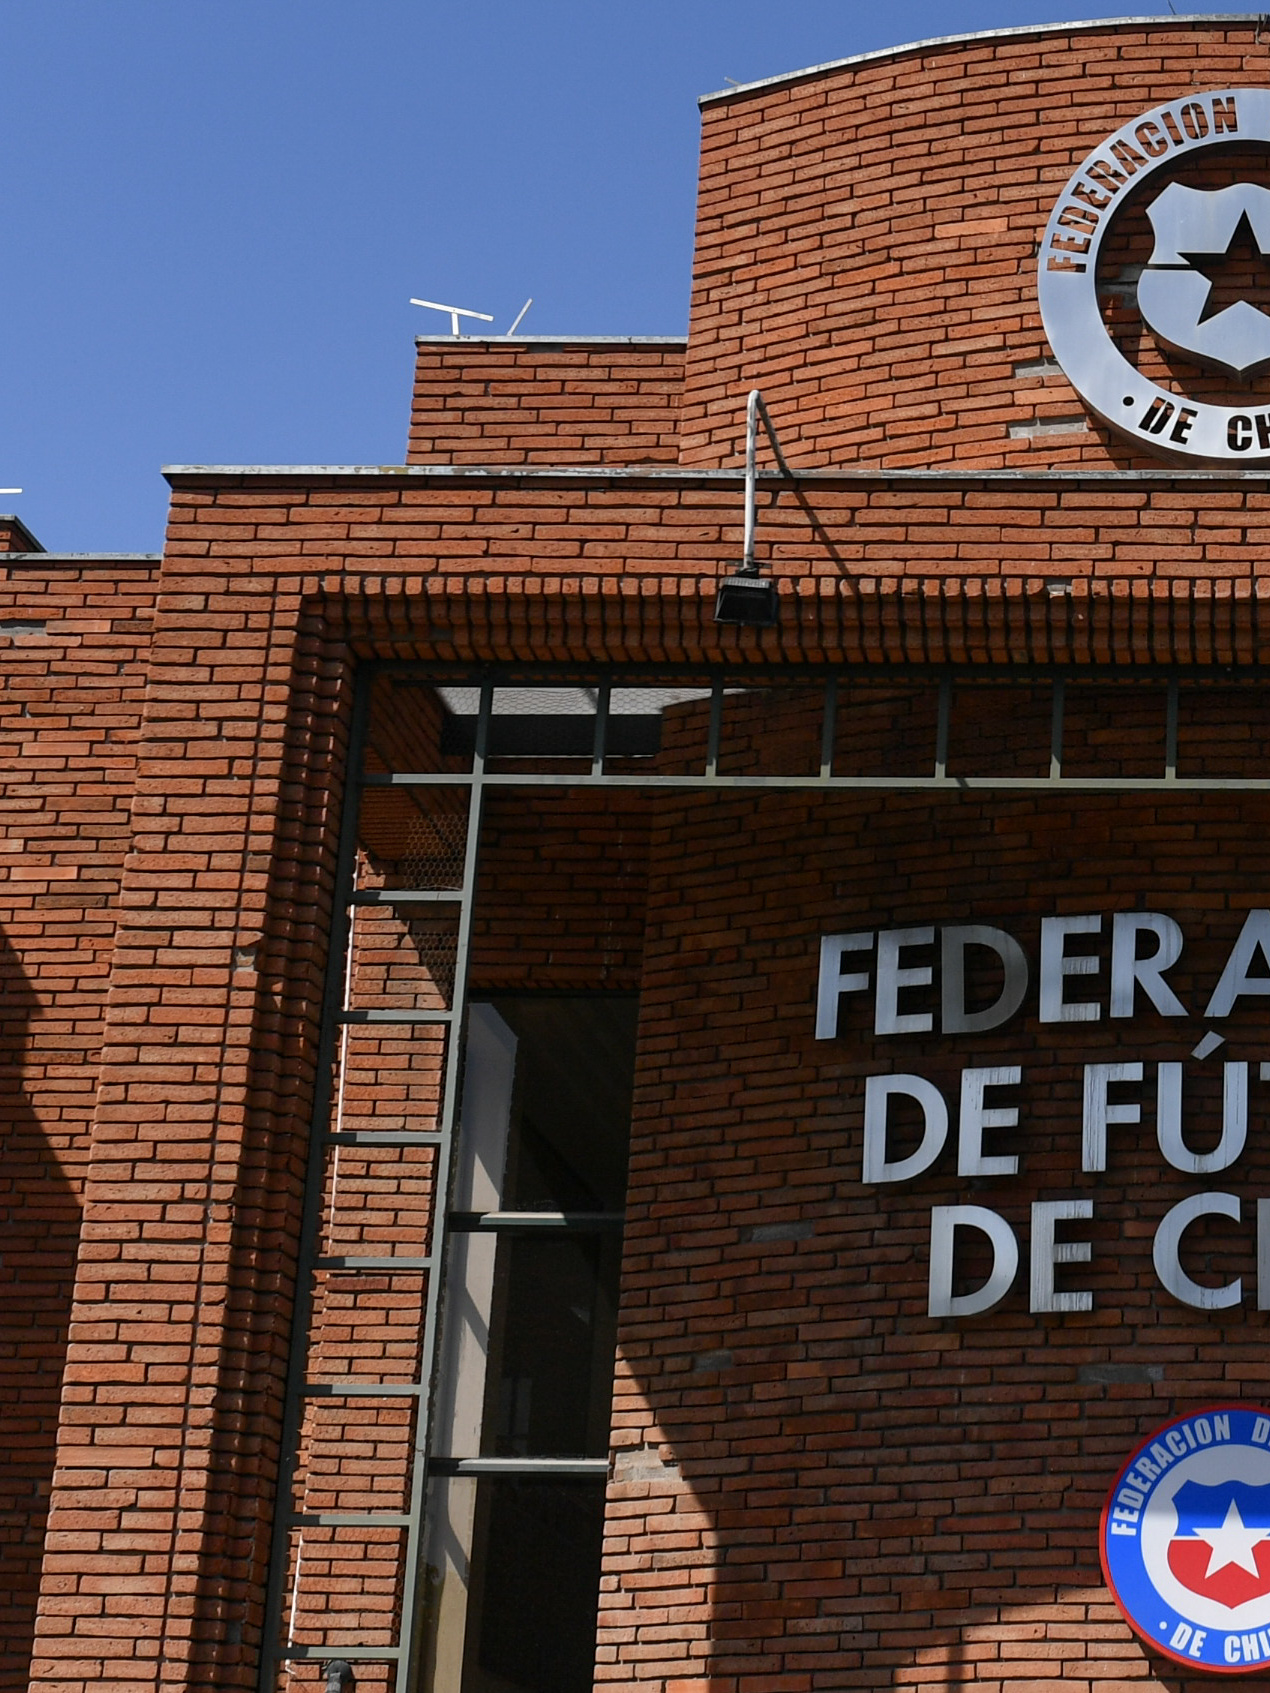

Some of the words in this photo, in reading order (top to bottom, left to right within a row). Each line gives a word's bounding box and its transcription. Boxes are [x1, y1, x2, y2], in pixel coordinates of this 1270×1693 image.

[1047, 96, 1239, 273] FEDERACION
[1138, 396, 1198, 445] DE
[862, 1066, 1022, 1184] DE
[928, 1201, 1094, 1317] DE
[1111, 1414, 1230, 1536] FEDERACION
[1169, 1621, 1207, 1657] DE
